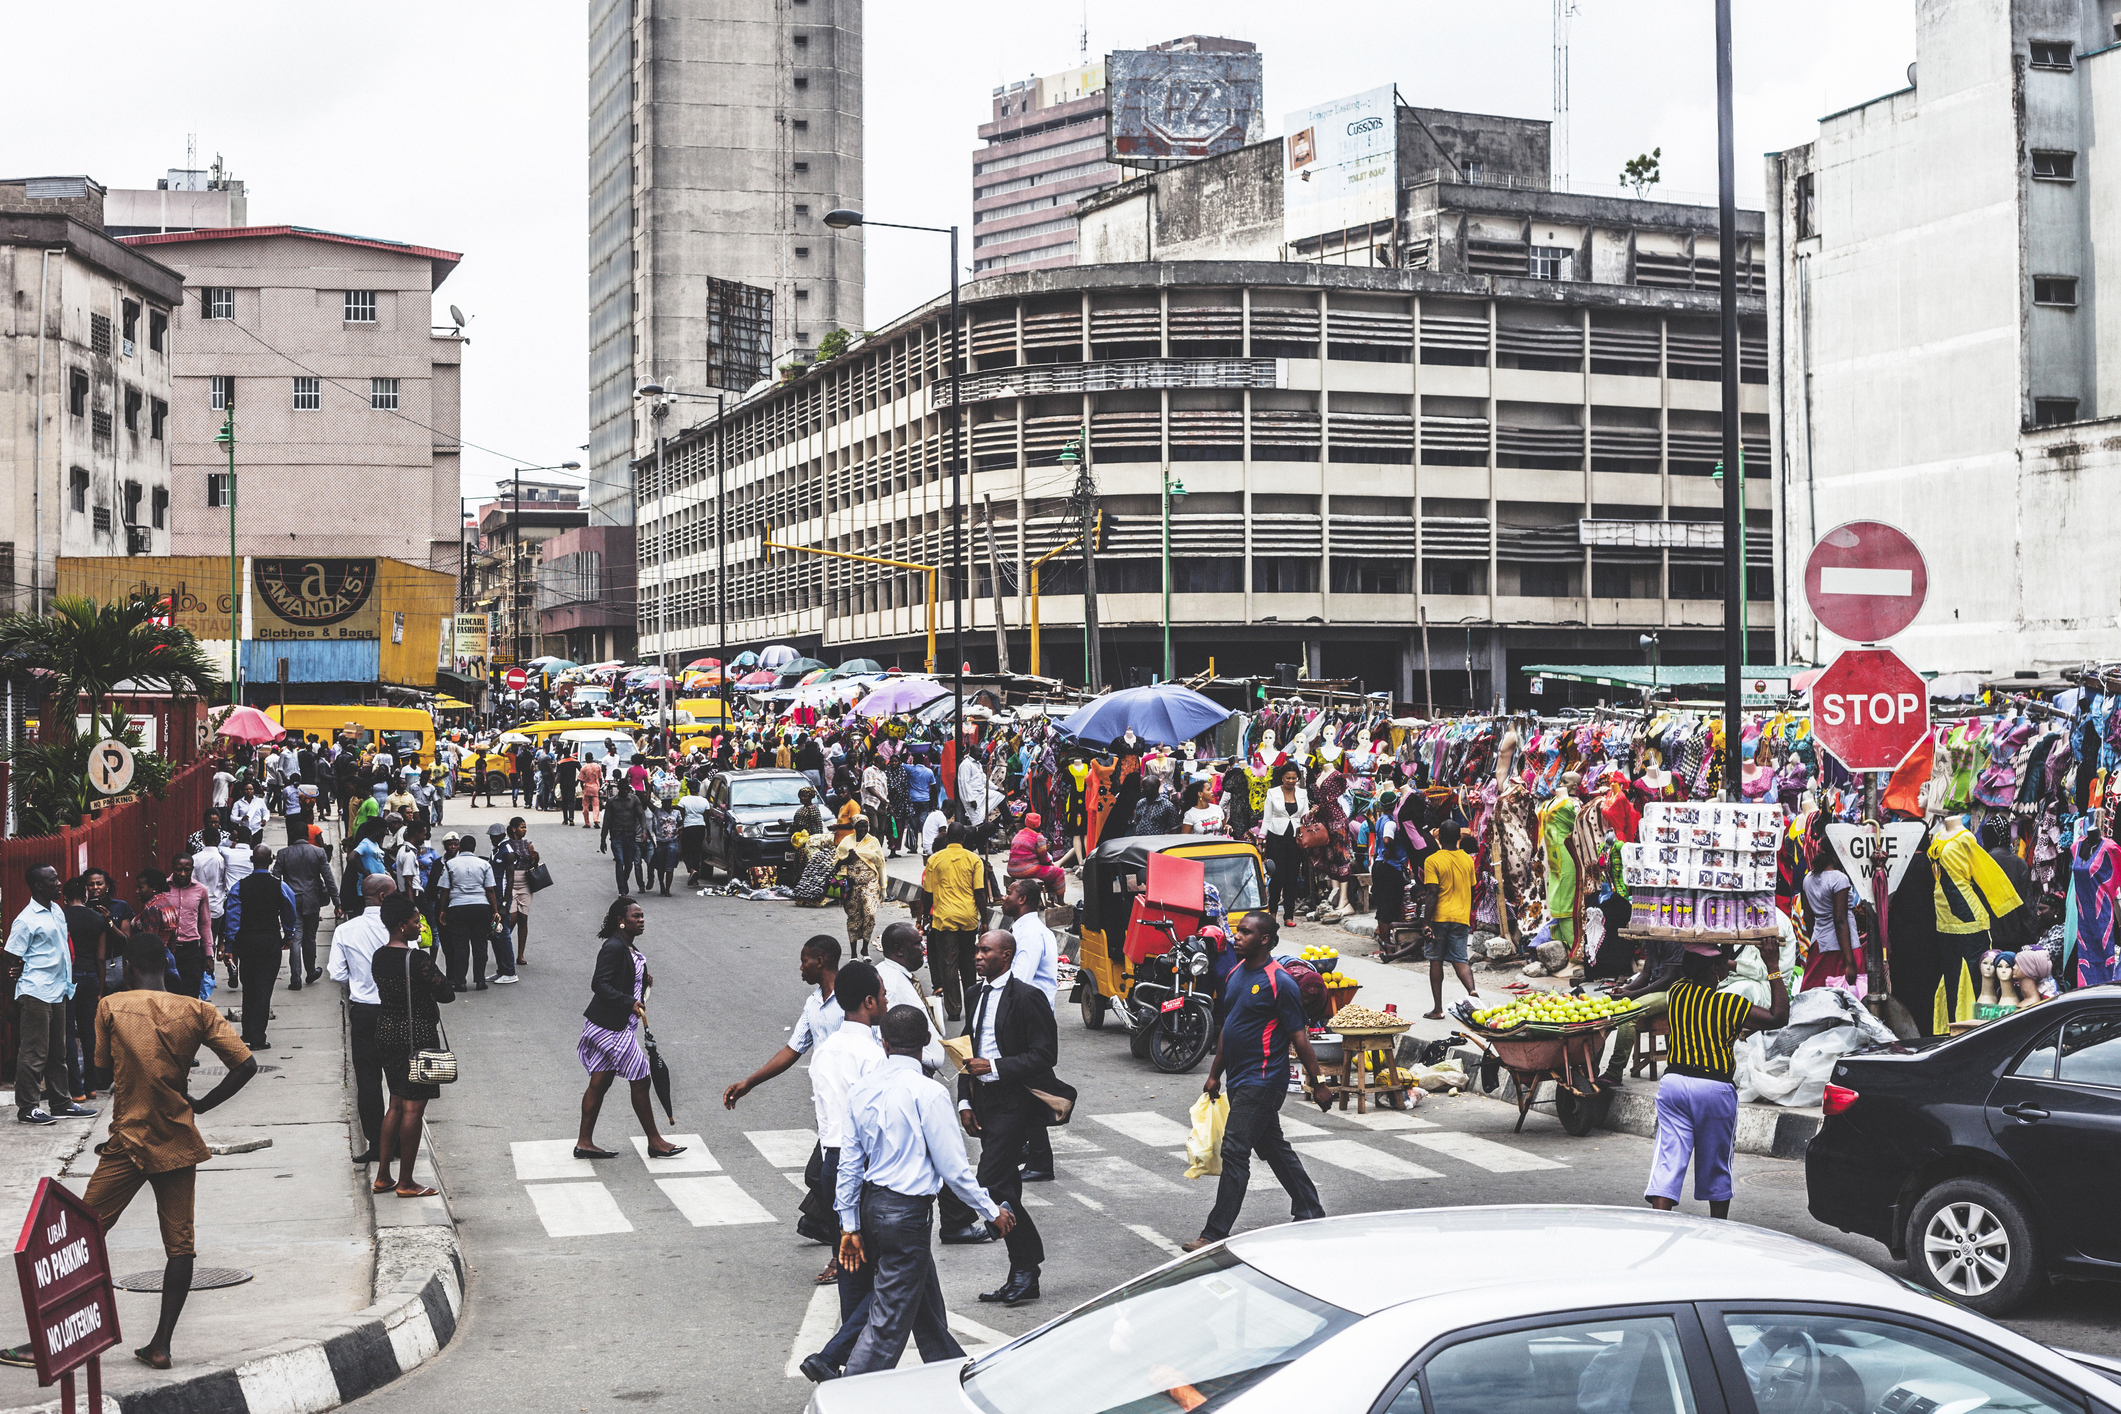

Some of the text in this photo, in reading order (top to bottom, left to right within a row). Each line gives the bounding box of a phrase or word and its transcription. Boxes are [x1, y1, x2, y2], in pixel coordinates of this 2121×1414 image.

[1309, 109, 1333, 122] Longer
[1347, 117, 1383, 136] Cussons
[1368, 166, 1387, 178] SOAP
[266, 577, 363, 617] AMANDA'S
[260, 628, 373, 638] Clothes & Bags
[457, 626, 486, 634] FASHIONS
[1823, 693, 1919, 725] STOP
[1861, 865, 1893, 878] WY
[47, 1221, 64, 1245] UBA
[34, 1237, 89, 1288] NO PARKING
[46, 1301, 101, 1355] NO LOITERING
